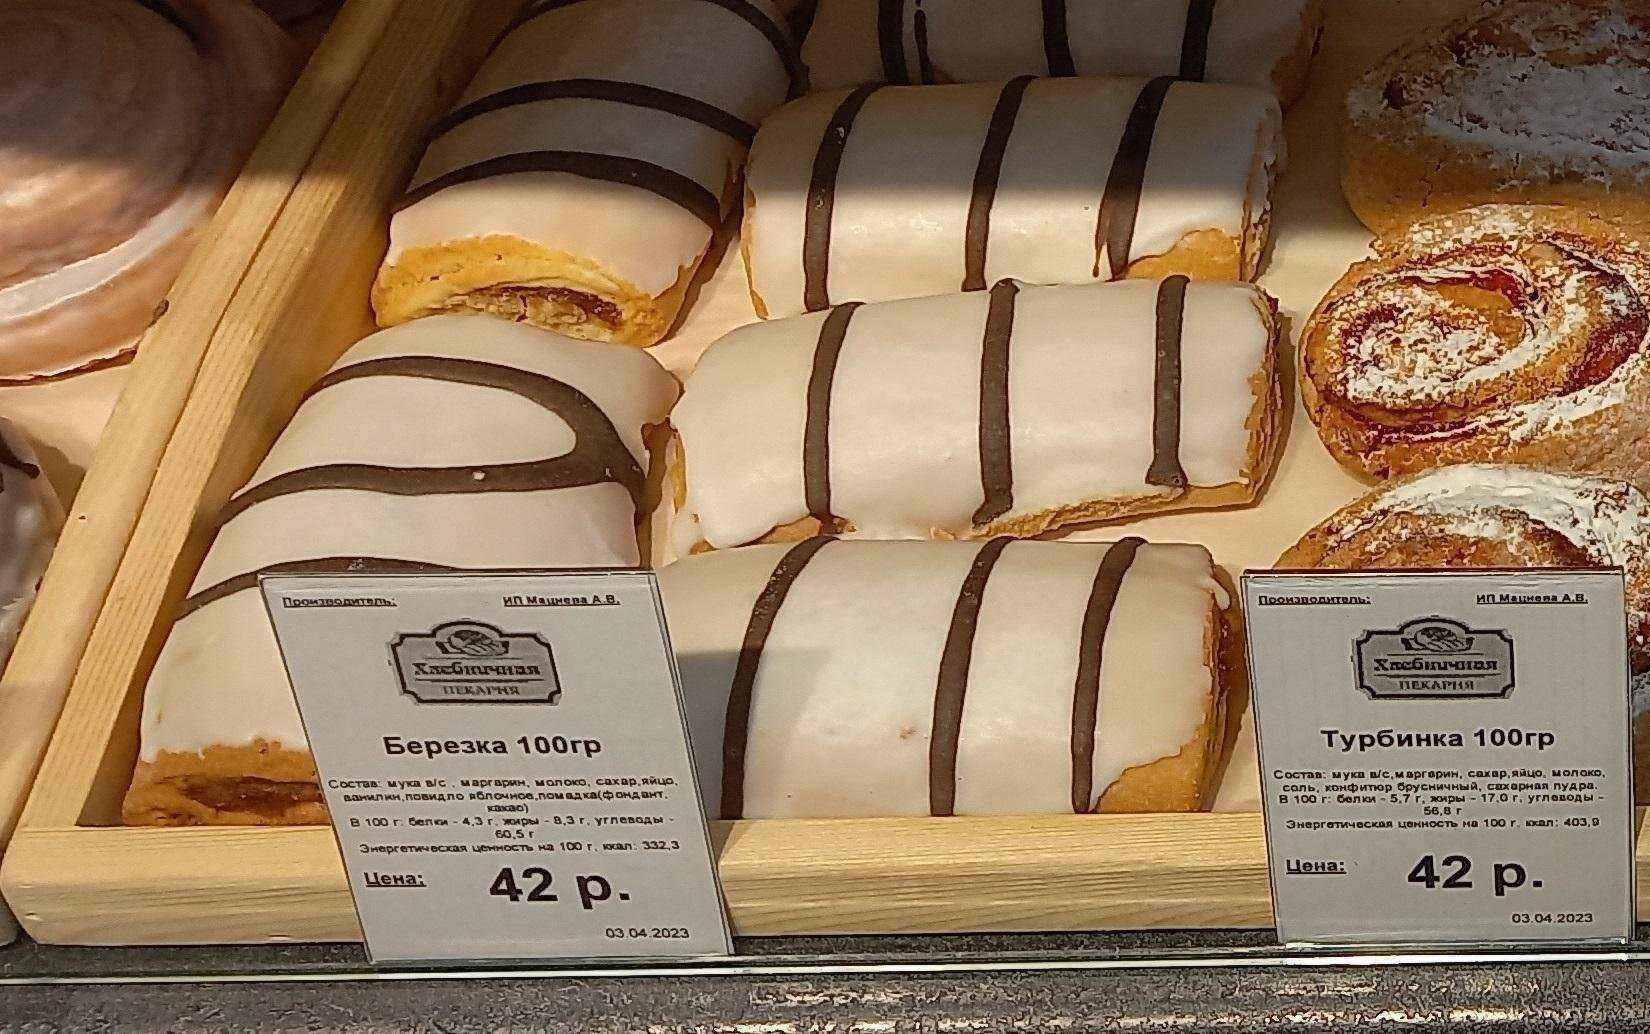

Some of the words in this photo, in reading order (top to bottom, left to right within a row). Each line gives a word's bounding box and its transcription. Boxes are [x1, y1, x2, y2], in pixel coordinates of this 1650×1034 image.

[503, 596, 522, 607] ИП
[1476, 594, 1496, 605] ИП
[1373, 658, 1498, 672] Хлебничная
[441, 685, 521, 697] ПЕКАРНЯ
[1400, 680, 1475, 691] ПЕКАРНЯ
[1320, 729, 1463, 752] Турбинка
[1474, 729, 1555, 750] 100гр
[383, 736, 508, 758] Березка
[517, 736, 601, 758] 100гр
[1273, 770, 1327, 779] Состав:
[1332, 772, 1365, 781] мука
[1552, 769, 1606, 779] молоко,
[388, 780, 421, 790] мука
[1282, 784, 1320, 793] соль,
[1325, 783, 1392, 793] конфитюр
[1397, 781, 1482, 792] брусничный,
[1487, 783, 1548, 793] сахарная
[1279, 795, 1288, 804] В
[1294, 795, 1317, 804] 100
[1336, 794, 1376, 804] белки
[1430, 795, 1465, 804] жиры
[1528, 793, 1593, 804] углеводы
[1423, 807, 1451, 817] 56,8
[351, 818, 360, 827] В
[366, 817, 388, 827] 100
[408, 817, 448, 827] белки
[462, 817, 483, 827] 4,3
[503, 817, 539, 827] жиры
[595, 815, 664, 826] углеводы
[1286, 820, 1393, 830] Энергетическая
[1398, 819, 1458, 829] ценность
[1463, 820, 1478, 828] на
[1484, 819, 1506, 827] 100
[1526, 819, 1558, 827] ккал:
[495, 829, 525, 839] 60,5
[359, 844, 467, 855] Энергетическая
[472, 843, 533, 854] ценность
[538, 843, 554, 851] на
[560, 842, 582, 851] 100
[642, 841, 680, 851] 332,3
[1286, 859, 1347, 875] Цена:
[364, 872, 427, 887] Цена:
[1407, 855, 1473, 889] 42
[1494, 861, 1543, 896] р.
[489, 867, 558, 902] 42
[576, 873, 632, 910] р.
[1511, 912, 1593, 924] 03.04.2023
[605, 927, 690, 940] 03.04.2023
